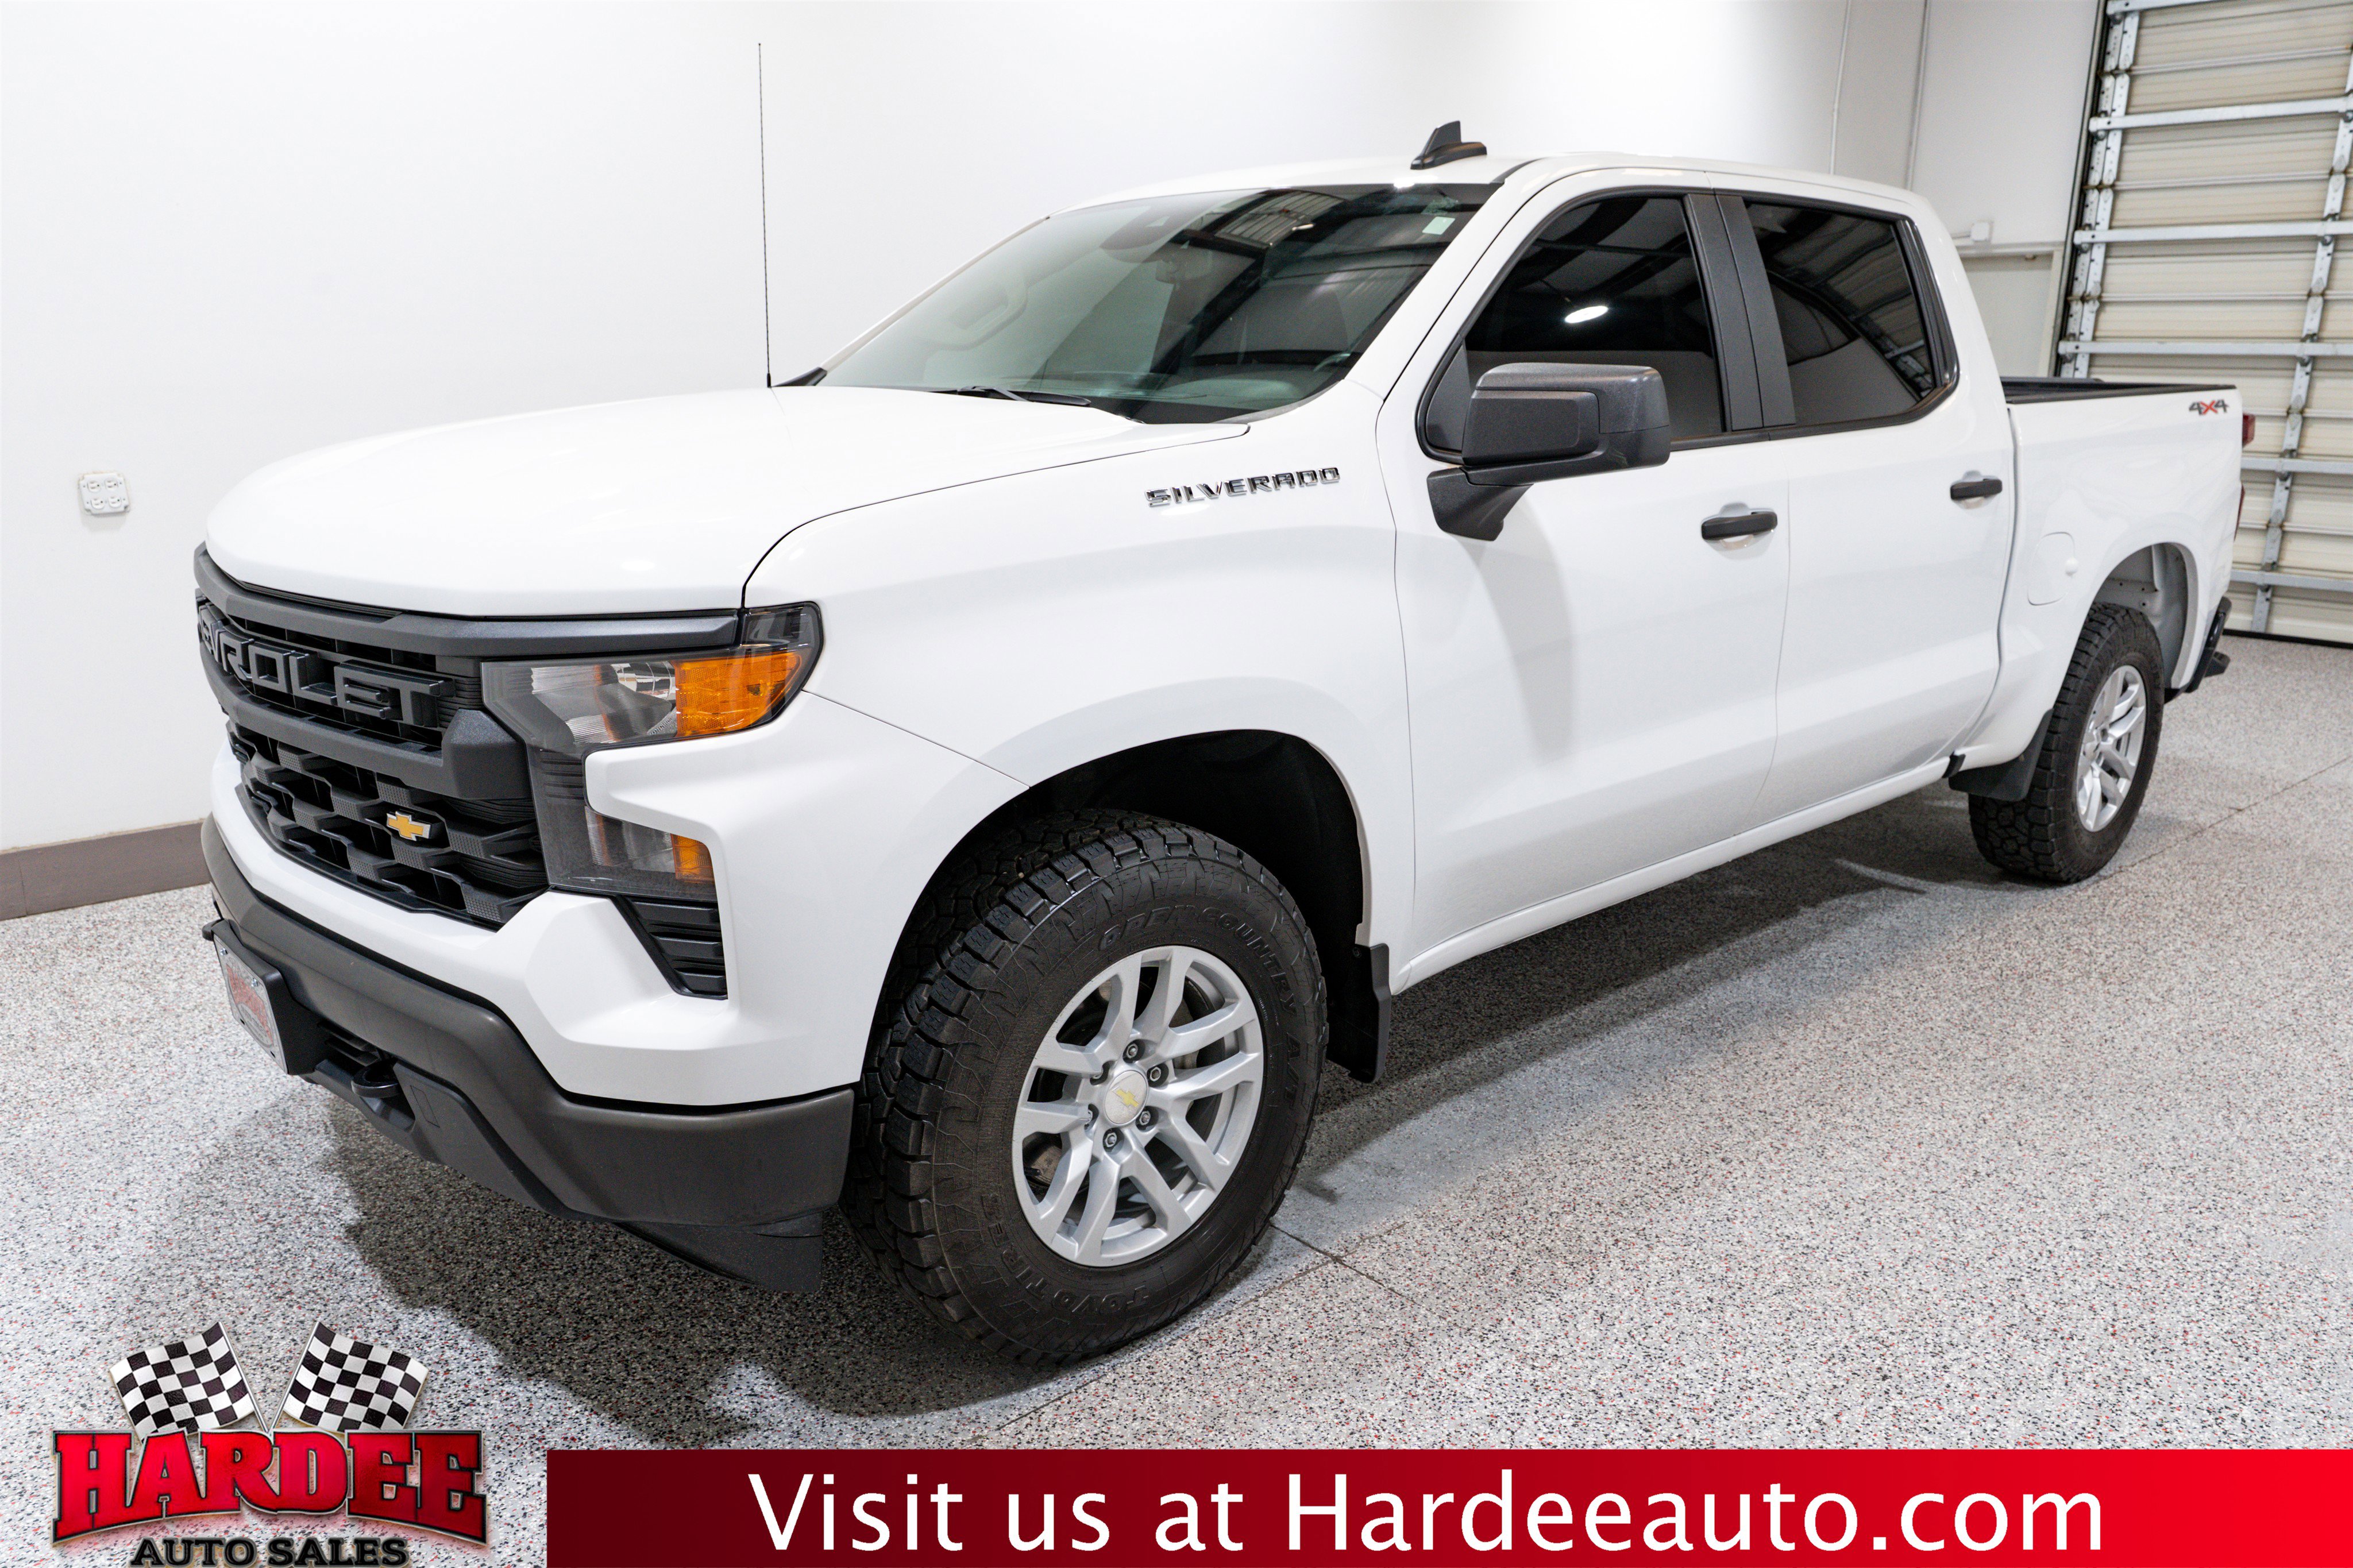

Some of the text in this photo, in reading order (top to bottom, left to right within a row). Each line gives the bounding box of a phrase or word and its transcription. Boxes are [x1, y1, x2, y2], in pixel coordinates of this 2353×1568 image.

[1144, 466, 1340, 507] SILVERADO
[1098, 905, 1197, 951] OPEN
[1198, 906, 1298, 1015] COUNTRY
[979, 1193, 1152, 1315] TOYO TIRES
